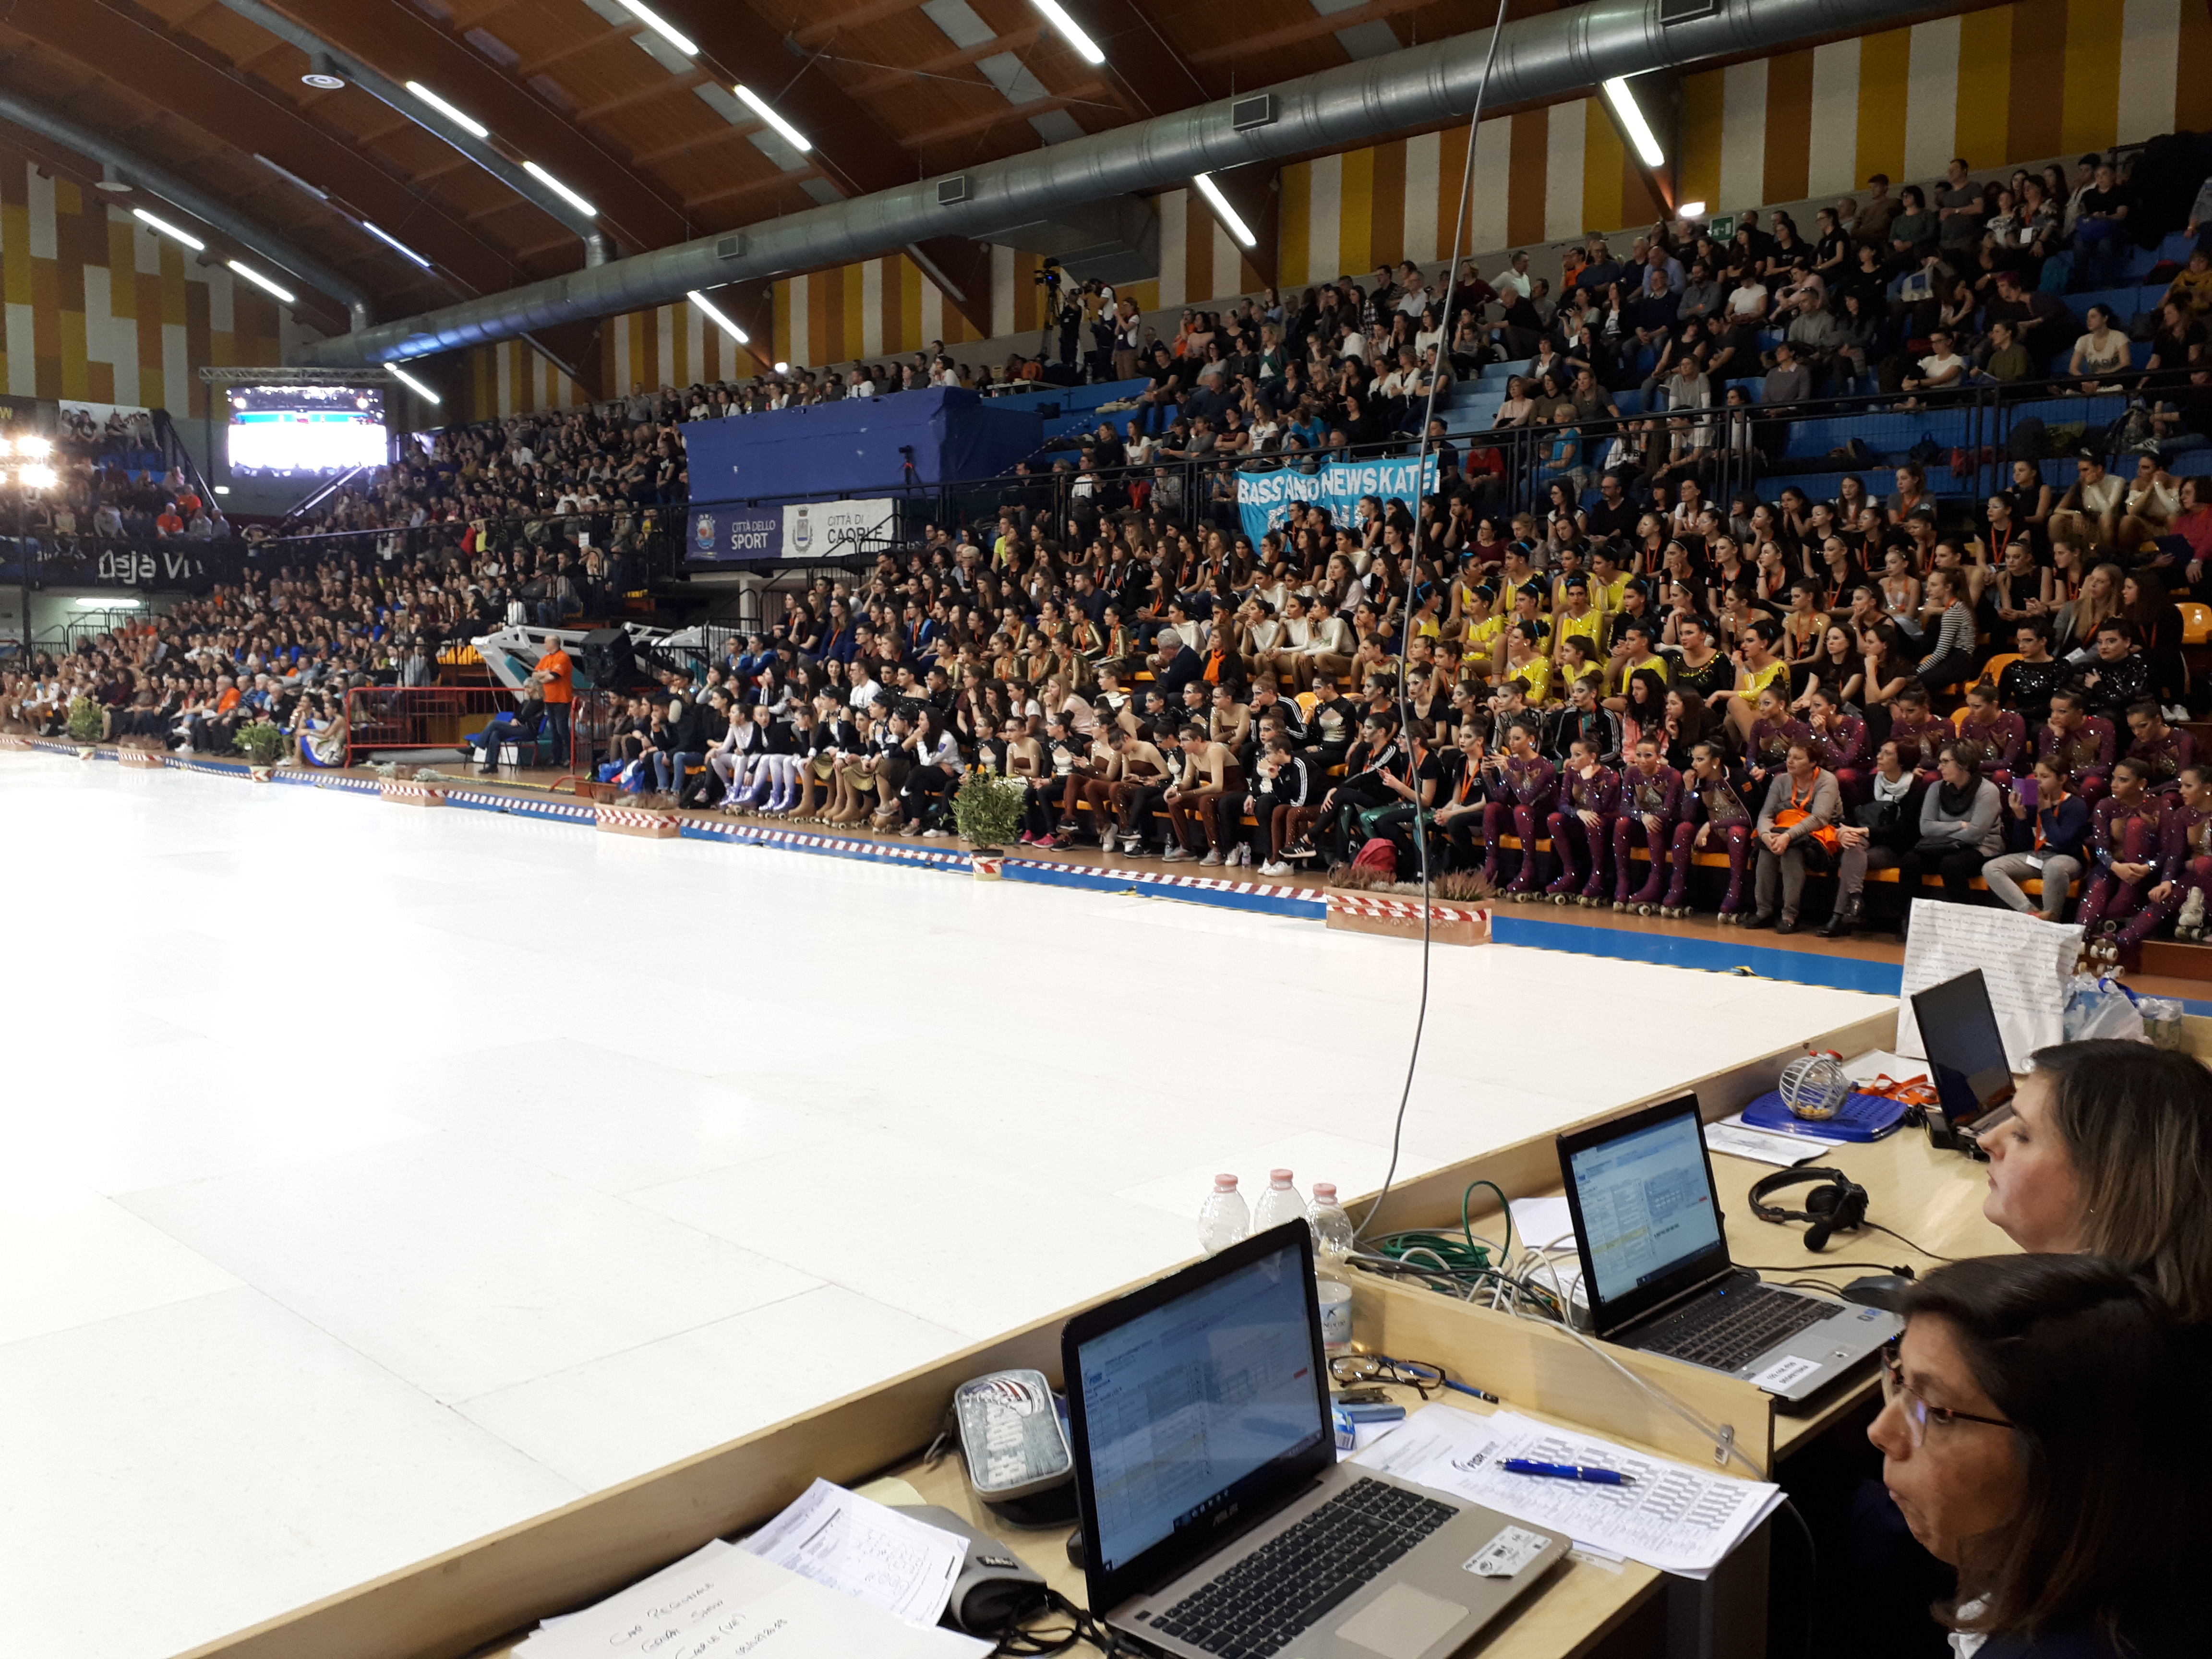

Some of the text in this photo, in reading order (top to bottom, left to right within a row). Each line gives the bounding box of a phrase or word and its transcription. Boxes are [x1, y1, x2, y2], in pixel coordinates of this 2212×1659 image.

[1238, 474, 1319, 506] BASSANO
[752, 520, 776, 531] DELLO
[854, 514, 864, 525] DI
[731, 532, 768, 550] SPORT
